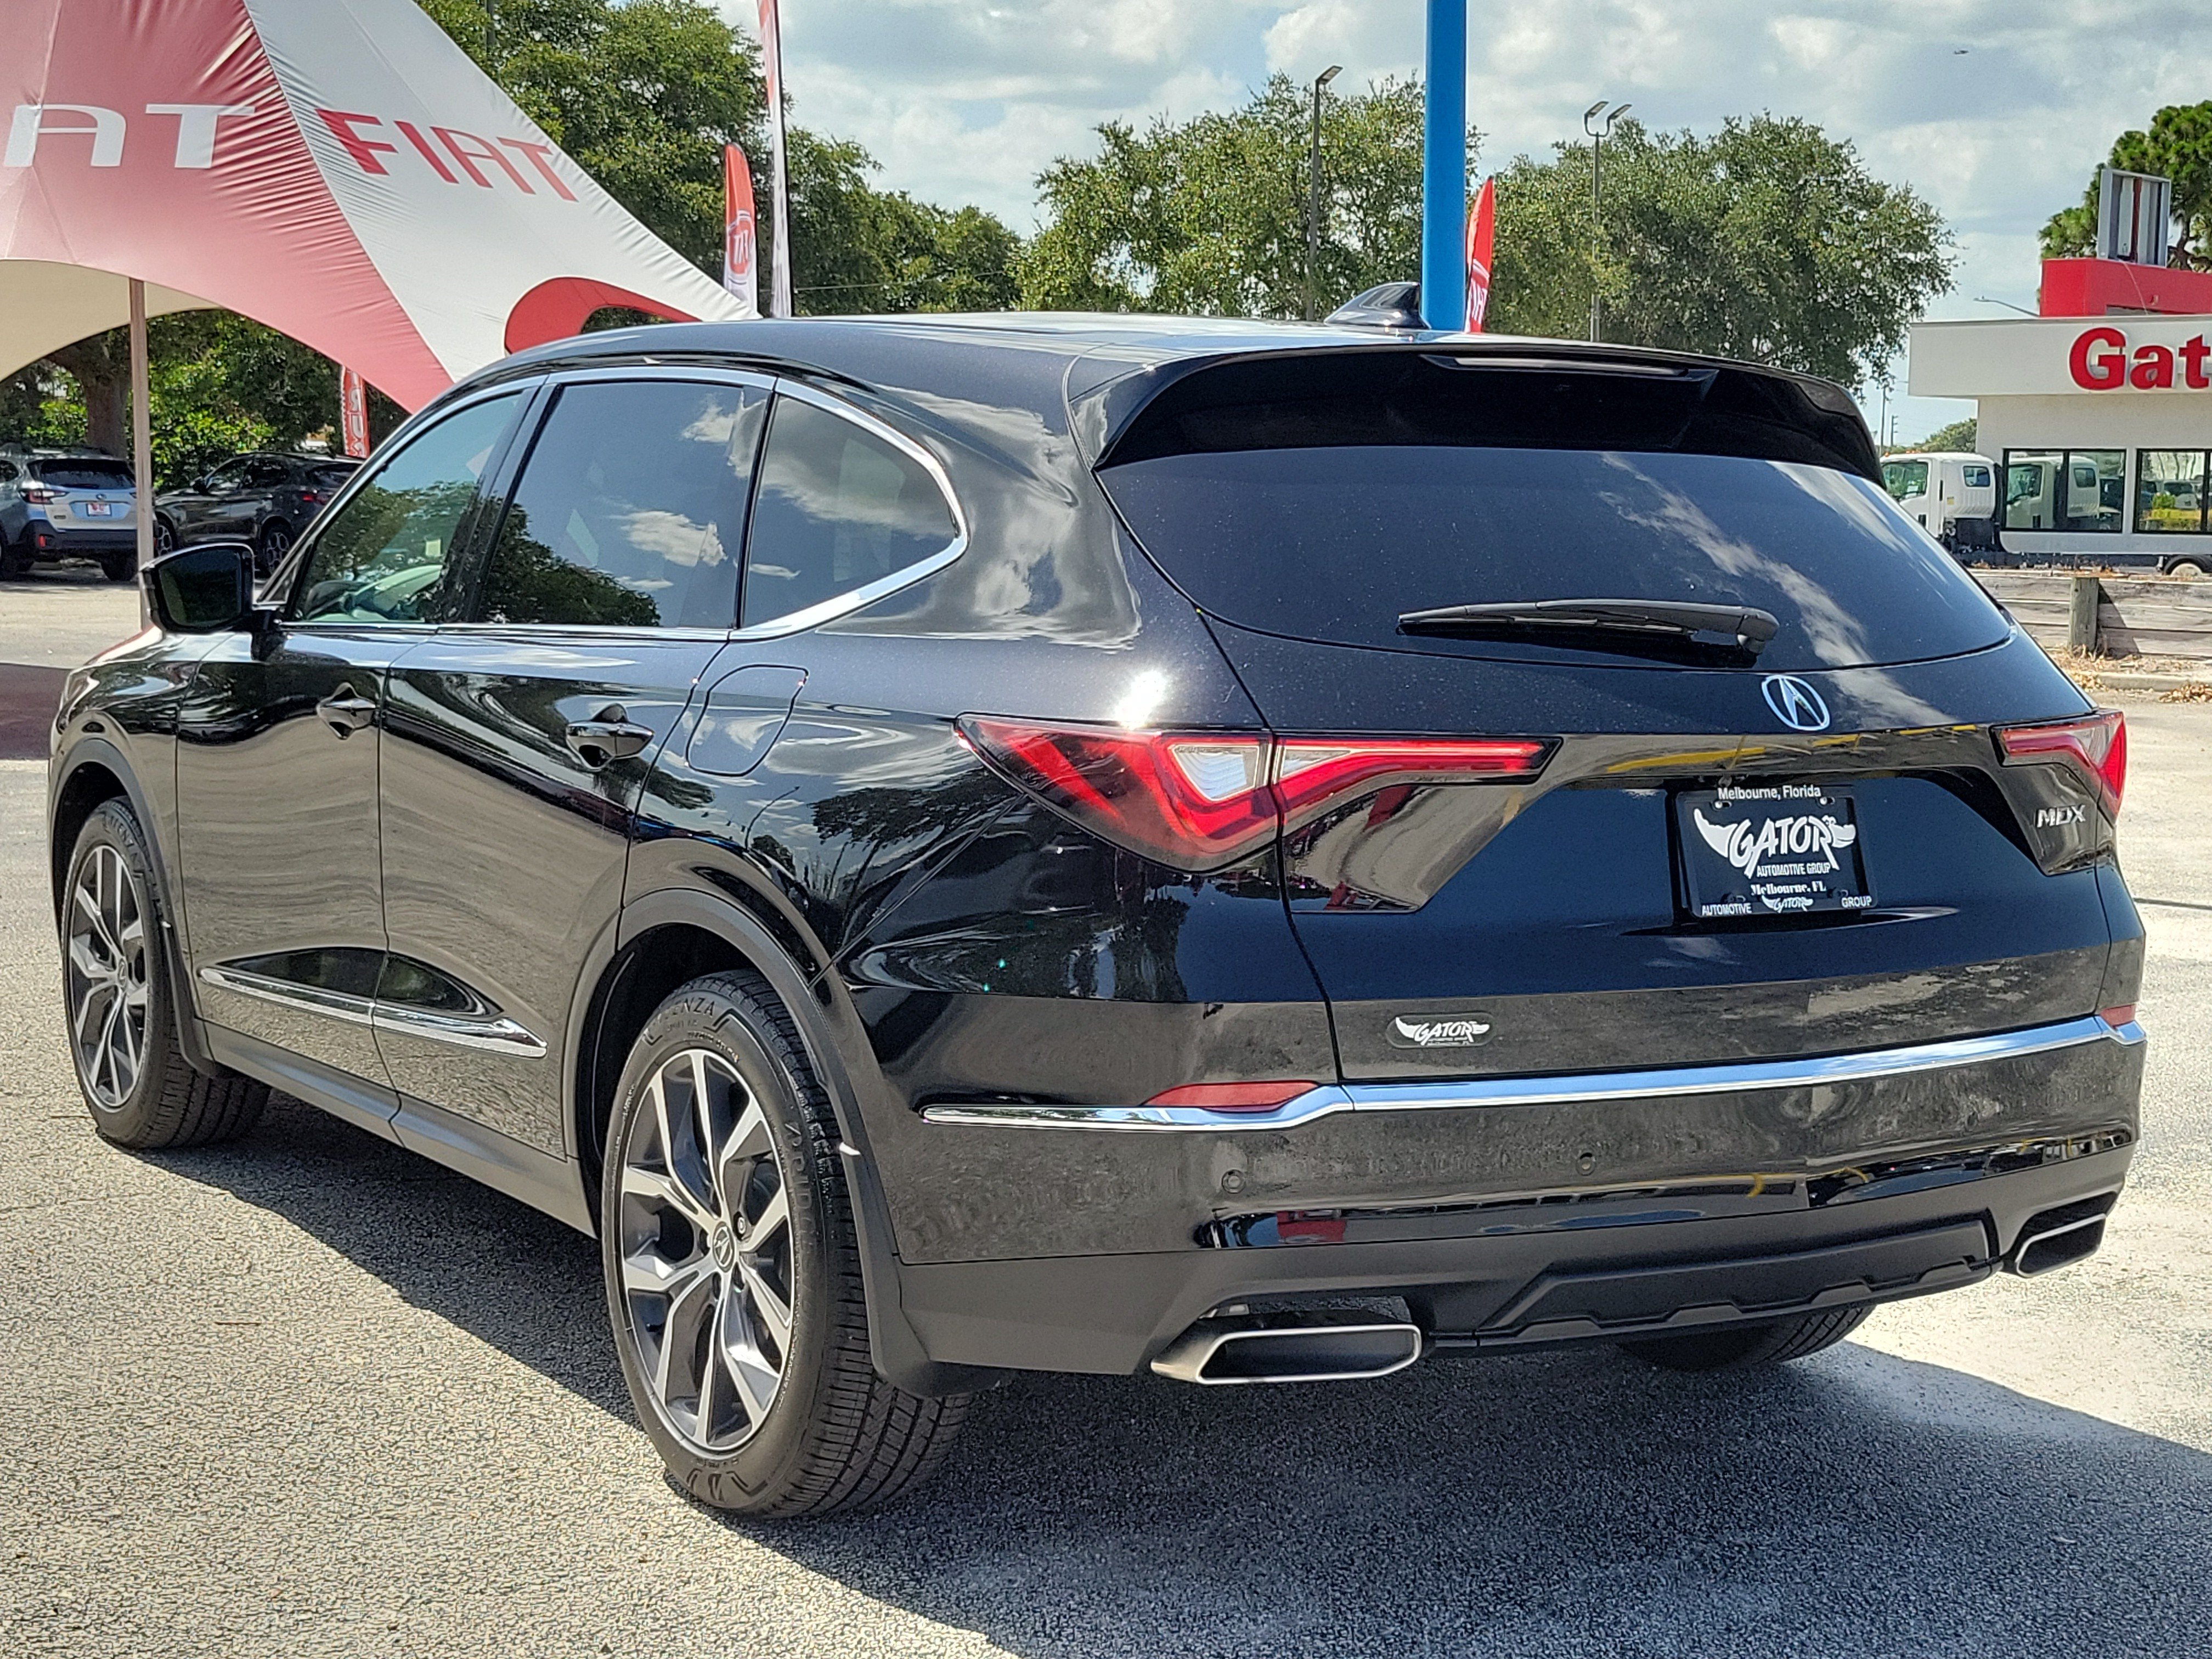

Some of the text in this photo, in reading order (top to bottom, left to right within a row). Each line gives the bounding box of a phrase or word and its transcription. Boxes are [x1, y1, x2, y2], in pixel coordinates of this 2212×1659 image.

[314, 108, 579, 203] FIAT
[2069, 326, 2211, 391] Gat
[1717, 784, 1822, 800] Melbourne, Florida
[2036, 804, 2086, 828] MDX
[1728, 815, 1840, 879] GATOR
[1757, 862, 1831, 877] AUTOMOTIVE GROUP
[1812, 881, 1827, 892] FL
[1701, 895, 1872, 916] AUTOMOTIVE GATOR GROUP
[1413, 1021, 1474, 1046] GATOR
